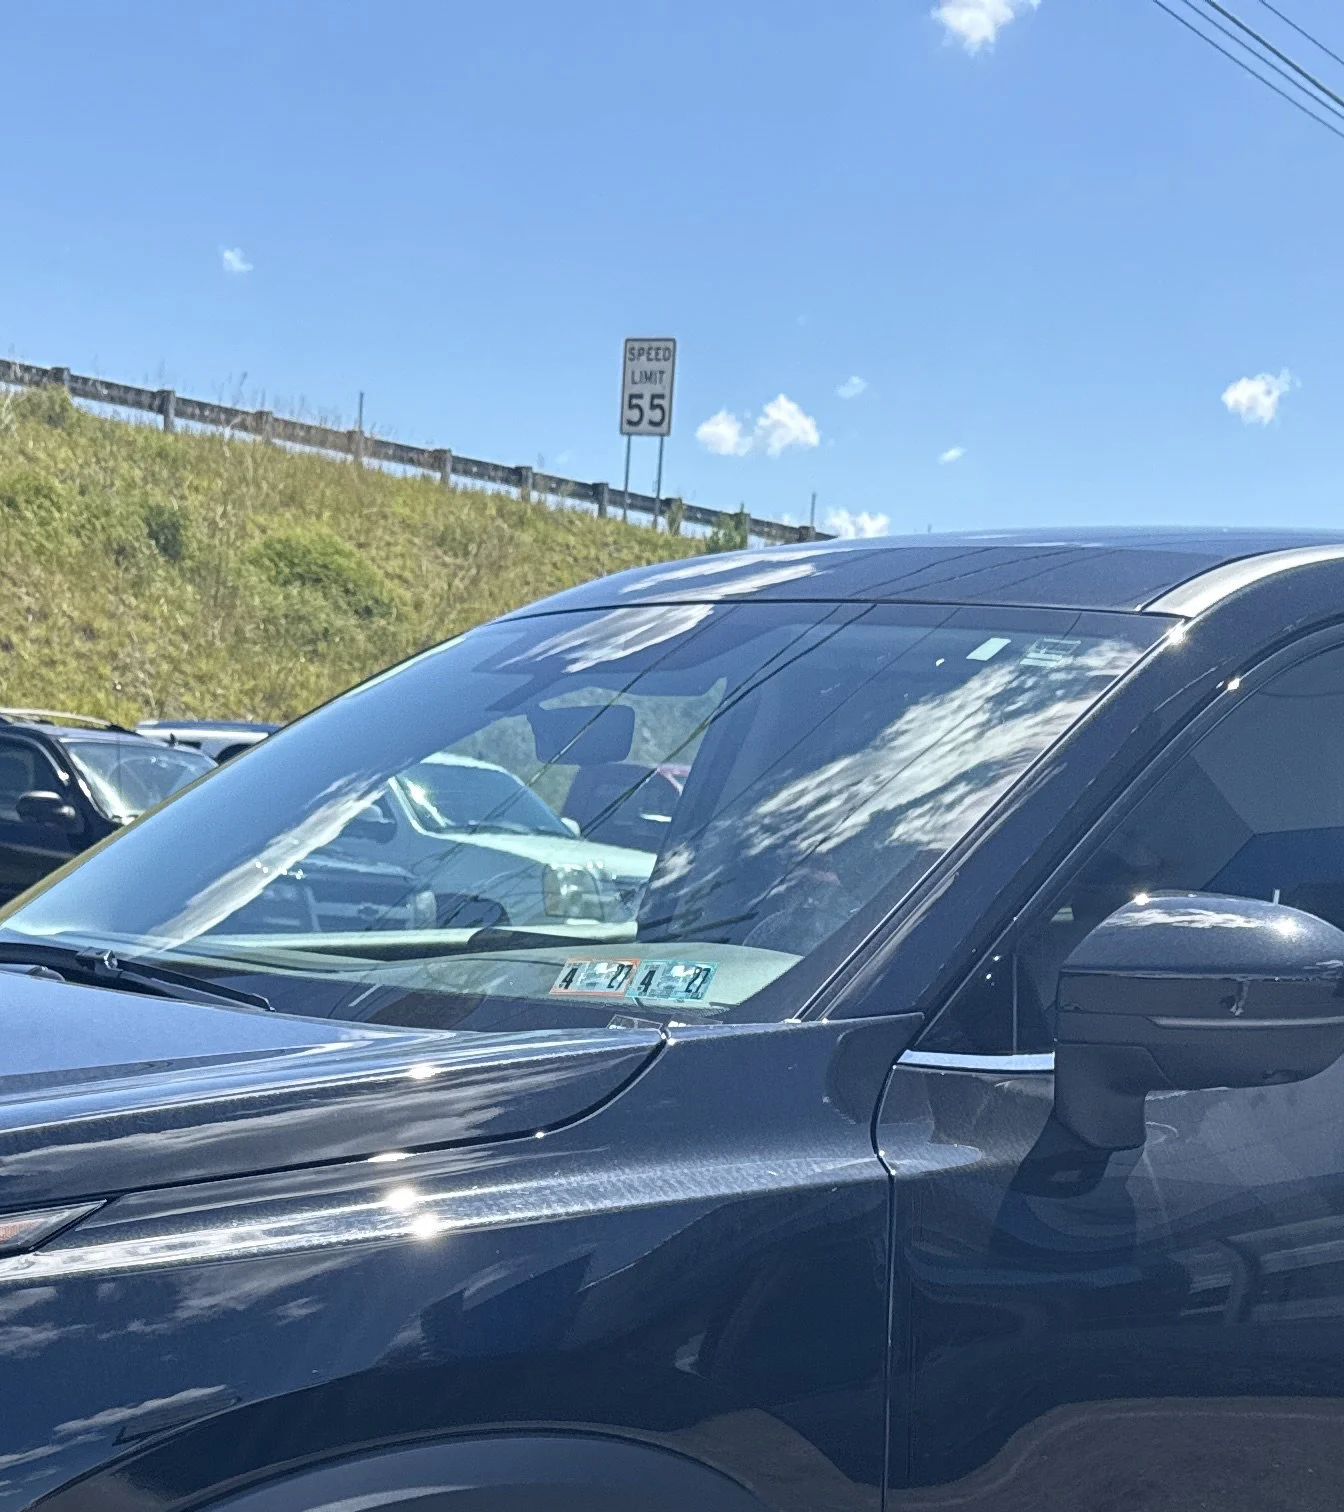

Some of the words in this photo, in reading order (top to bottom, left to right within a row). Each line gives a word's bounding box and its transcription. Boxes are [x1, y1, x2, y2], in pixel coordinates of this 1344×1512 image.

[628, 346, 672, 362] SPEED
[631, 370, 665, 385] LIMIT
[626, 393, 666, 427] 55
[561, 967, 578, 990] 4
[639, 969, 657, 993] 4
